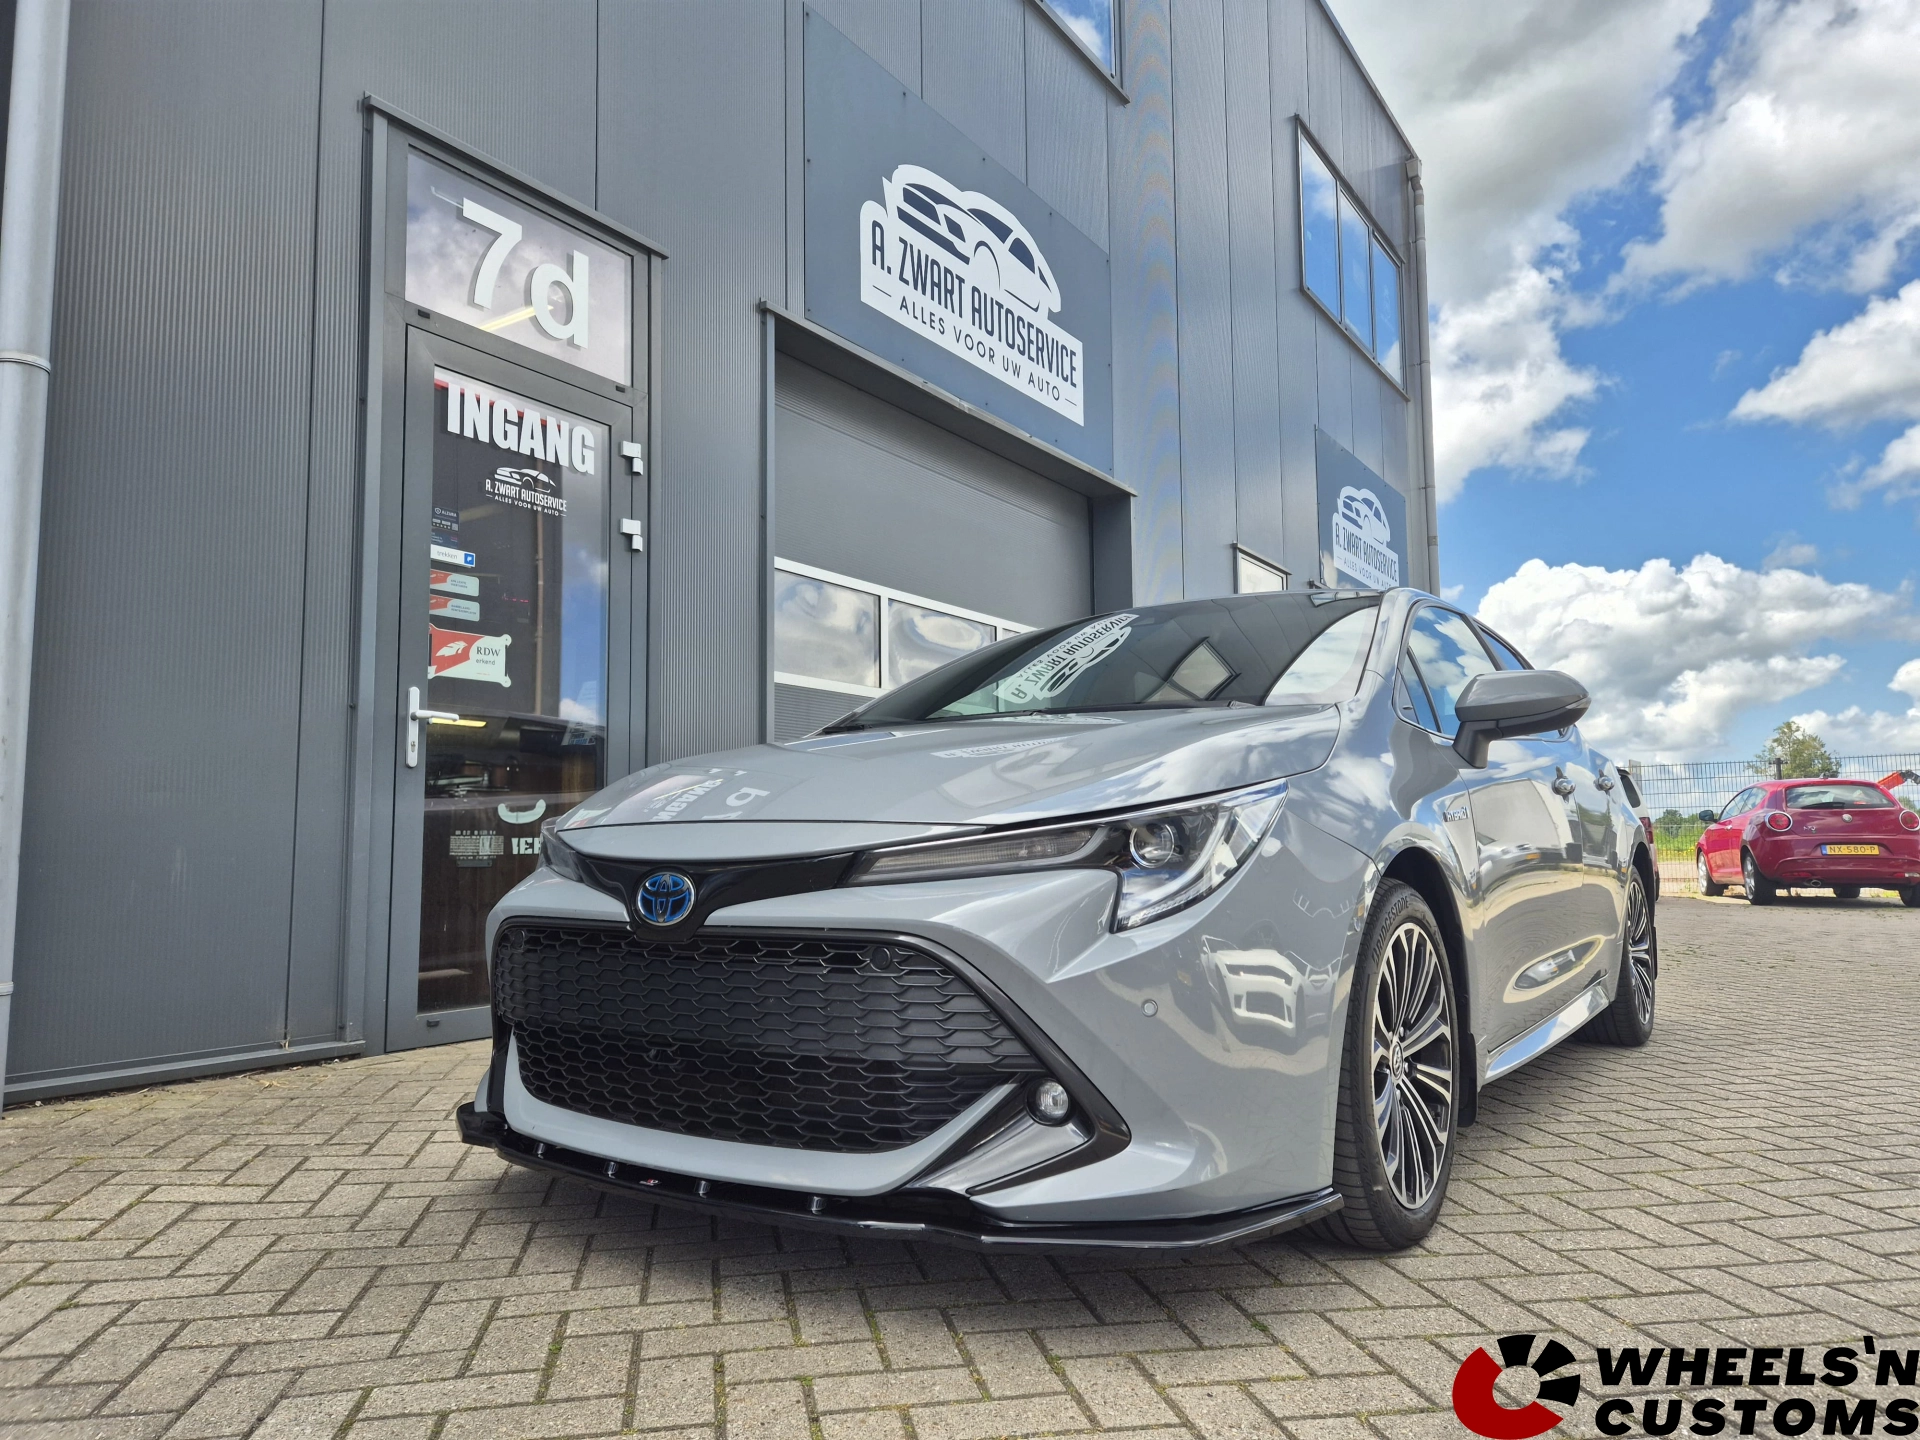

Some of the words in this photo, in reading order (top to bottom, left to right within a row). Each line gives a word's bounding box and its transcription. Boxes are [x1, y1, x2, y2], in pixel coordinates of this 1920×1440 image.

[463, 197, 589, 349] 7d
[871, 219, 892, 275] A.
[898, 236, 965, 318] ZWART
[971, 285, 1077, 388] AUTOSERVICE
[899, 295, 945, 335] ALLES
[953, 325, 995, 365] VOOR
[1002, 354, 1021, 379] UW
[1028, 371, 1060, 401] AUTO
[447, 382, 595, 475] INGANG
[485, 478, 493, 493] A.
[494, 481, 519, 500] ZWART
[521, 488, 567, 512] AUTOSERVICE
[494, 495, 512, 505] ALLES
[514, 499, 532, 510] VOOR
[533, 504, 543, 512] UW
[544, 506, 559, 517] AUTO
[1335, 522, 1342, 548] A.
[1343, 526, 1362, 560] ZWART
[1363, 540, 1398, 582] AUTOSERVICE
[1343, 559, 1358, 572] ALLES
[1360, 564, 1372, 579] VOOR
[475, 658, 496, 666] erkend
[476, 646, 501, 657] RDW
